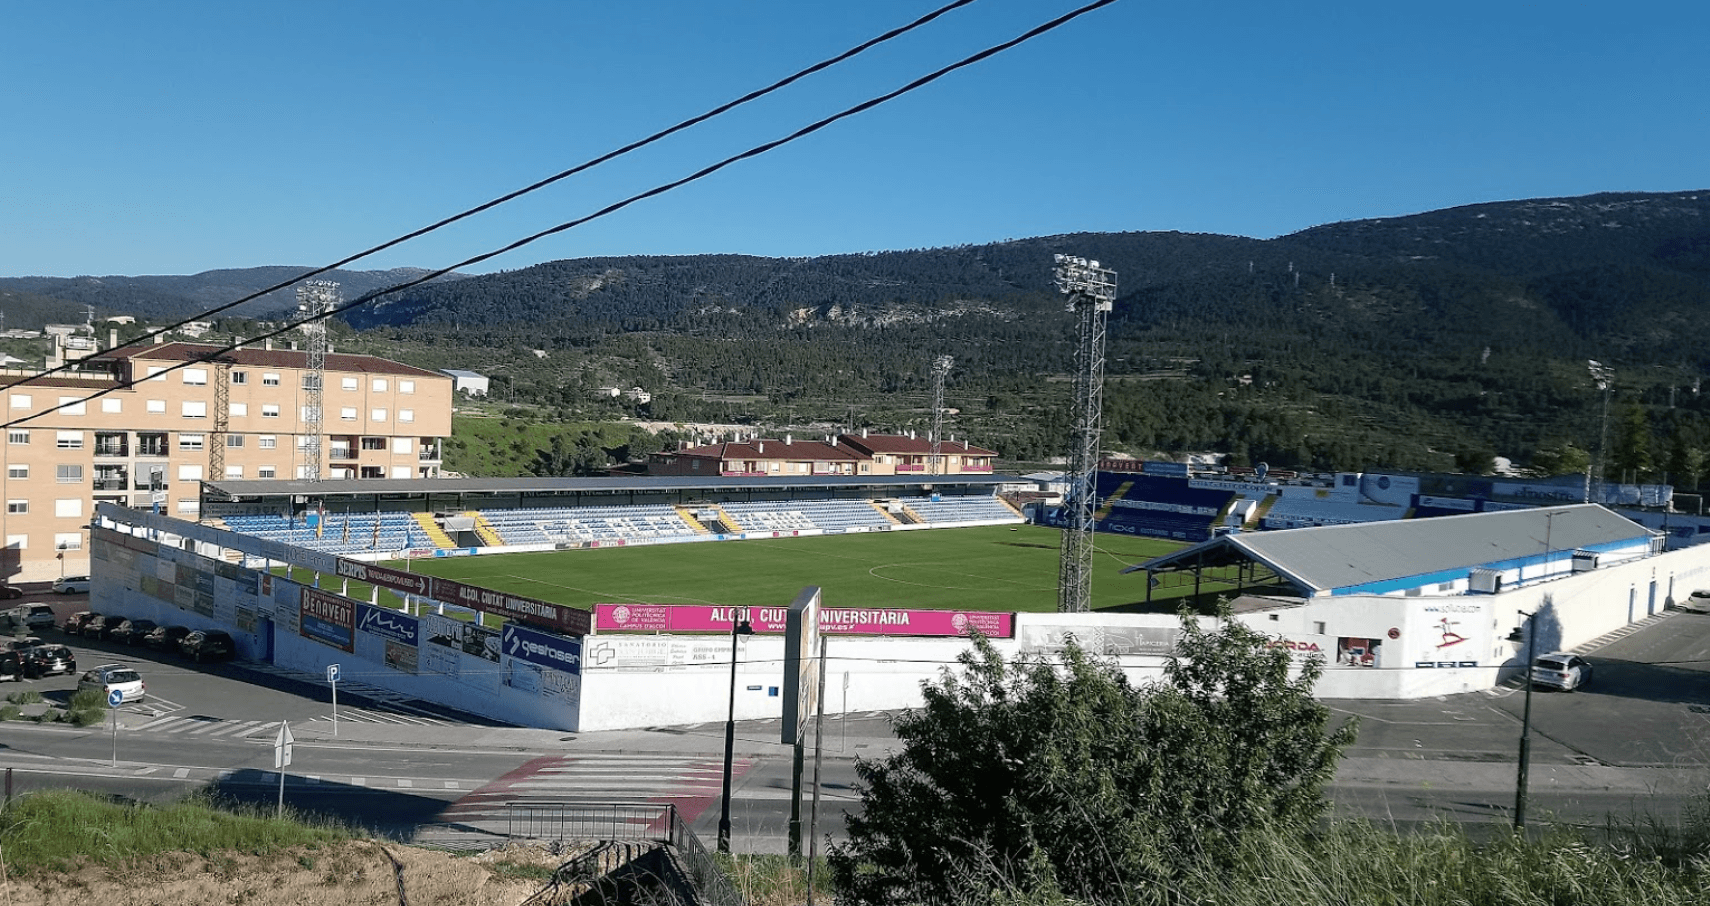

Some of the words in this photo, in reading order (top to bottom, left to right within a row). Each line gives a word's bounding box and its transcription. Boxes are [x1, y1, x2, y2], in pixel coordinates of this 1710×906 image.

[338, 558, 367, 580] SERPIS
[303, 589, 352, 624] BENAVENT
[481, 592, 504, 607] CIUTAT
[505, 596, 558, 620] UNIVERSITÀRIA
[760, 608, 787, 622] CIUT
[820, 609, 910, 625] NIVERSITÀRIA
[359, 607, 415, 640] Miró
[521, 639, 580, 665] gestaser
[330, 666, 338, 680] P
